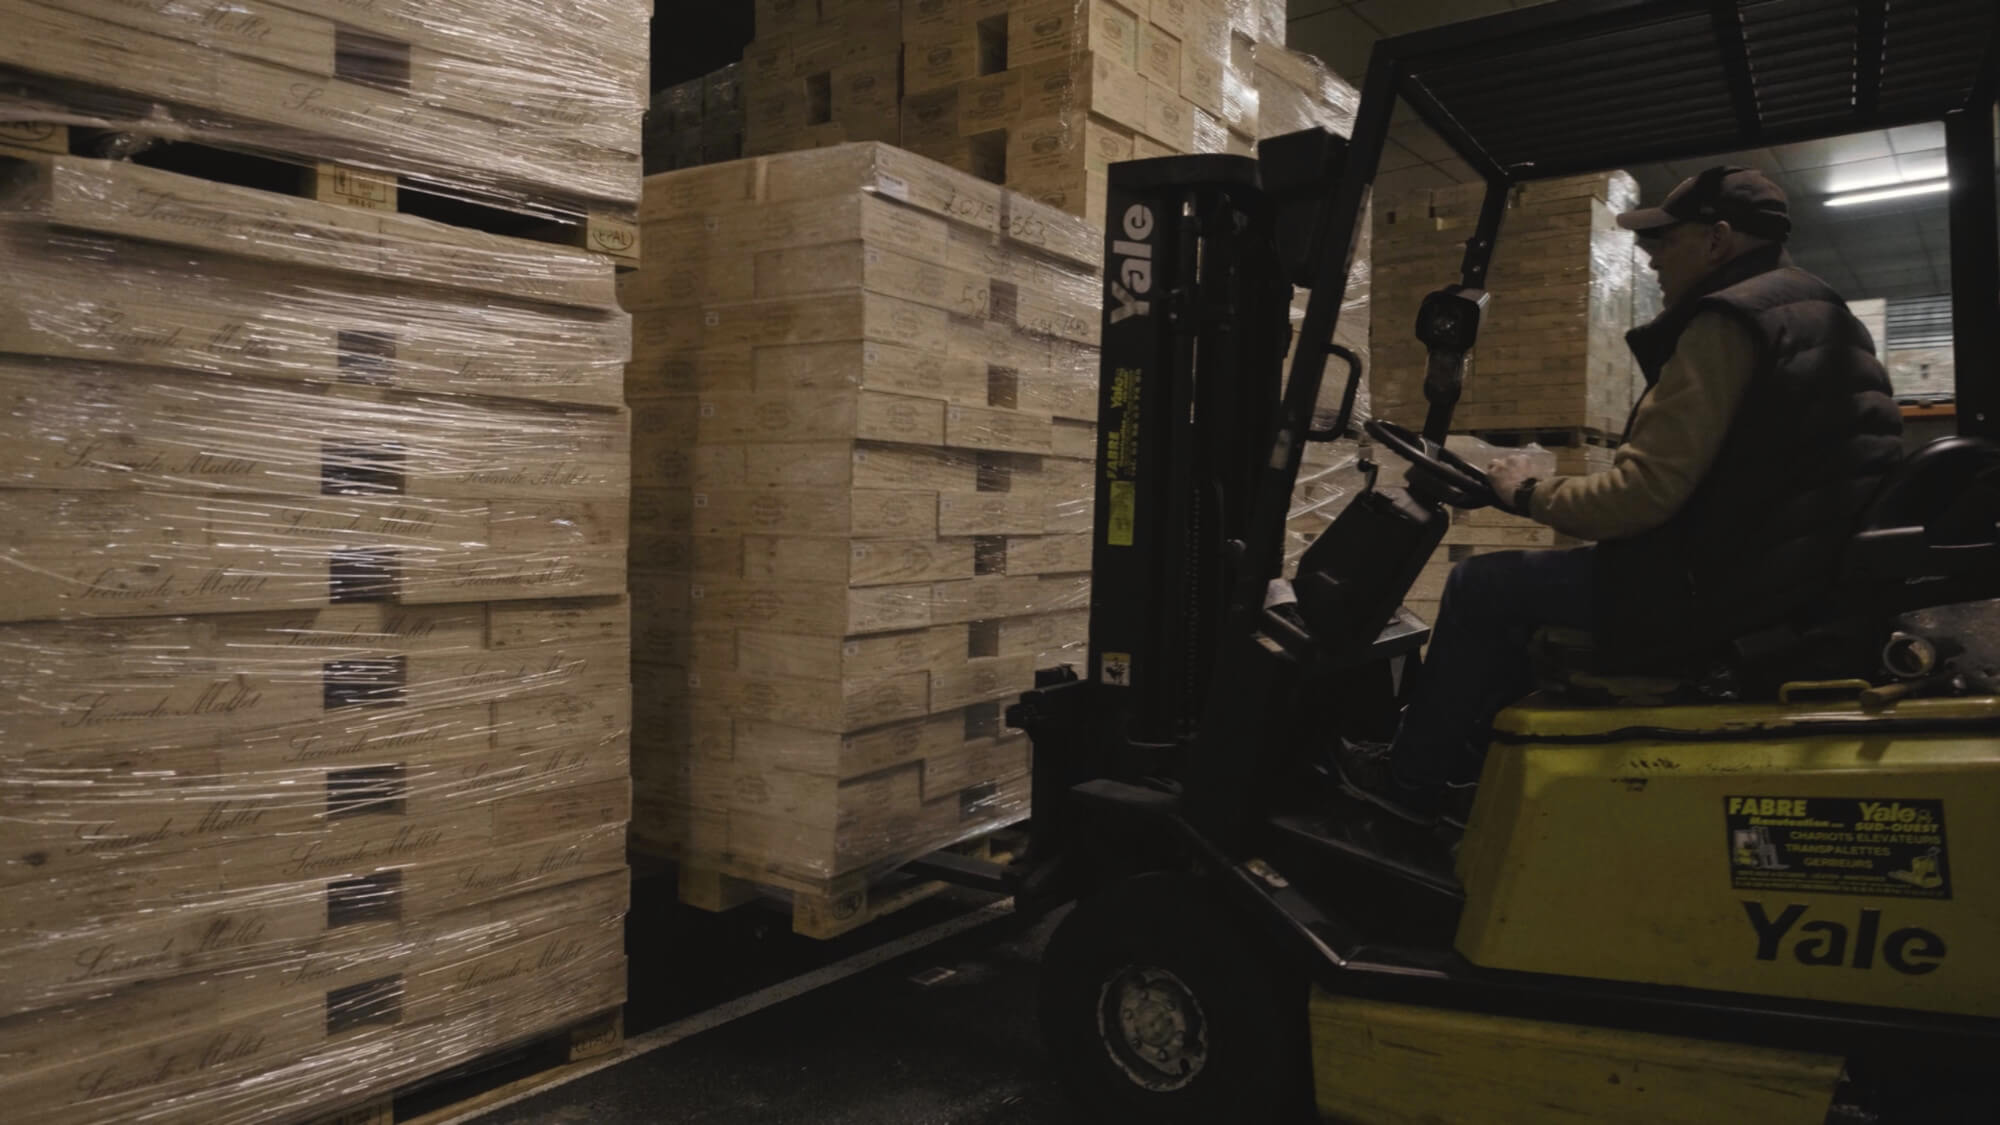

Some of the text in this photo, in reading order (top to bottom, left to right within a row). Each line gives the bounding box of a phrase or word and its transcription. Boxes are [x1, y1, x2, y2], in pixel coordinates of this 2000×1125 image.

[1110, 204, 1153, 324] Yale
[1728, 798, 1916, 823] FABRE Yale
[1855, 822, 1939, 833] SUD-OUEST
[1789, 831, 1941, 844] CHARIOTS ELEVATEURS
[1784, 843, 1891, 856] TRANSPALETTES
[1741, 901, 1947, 975] Yale
